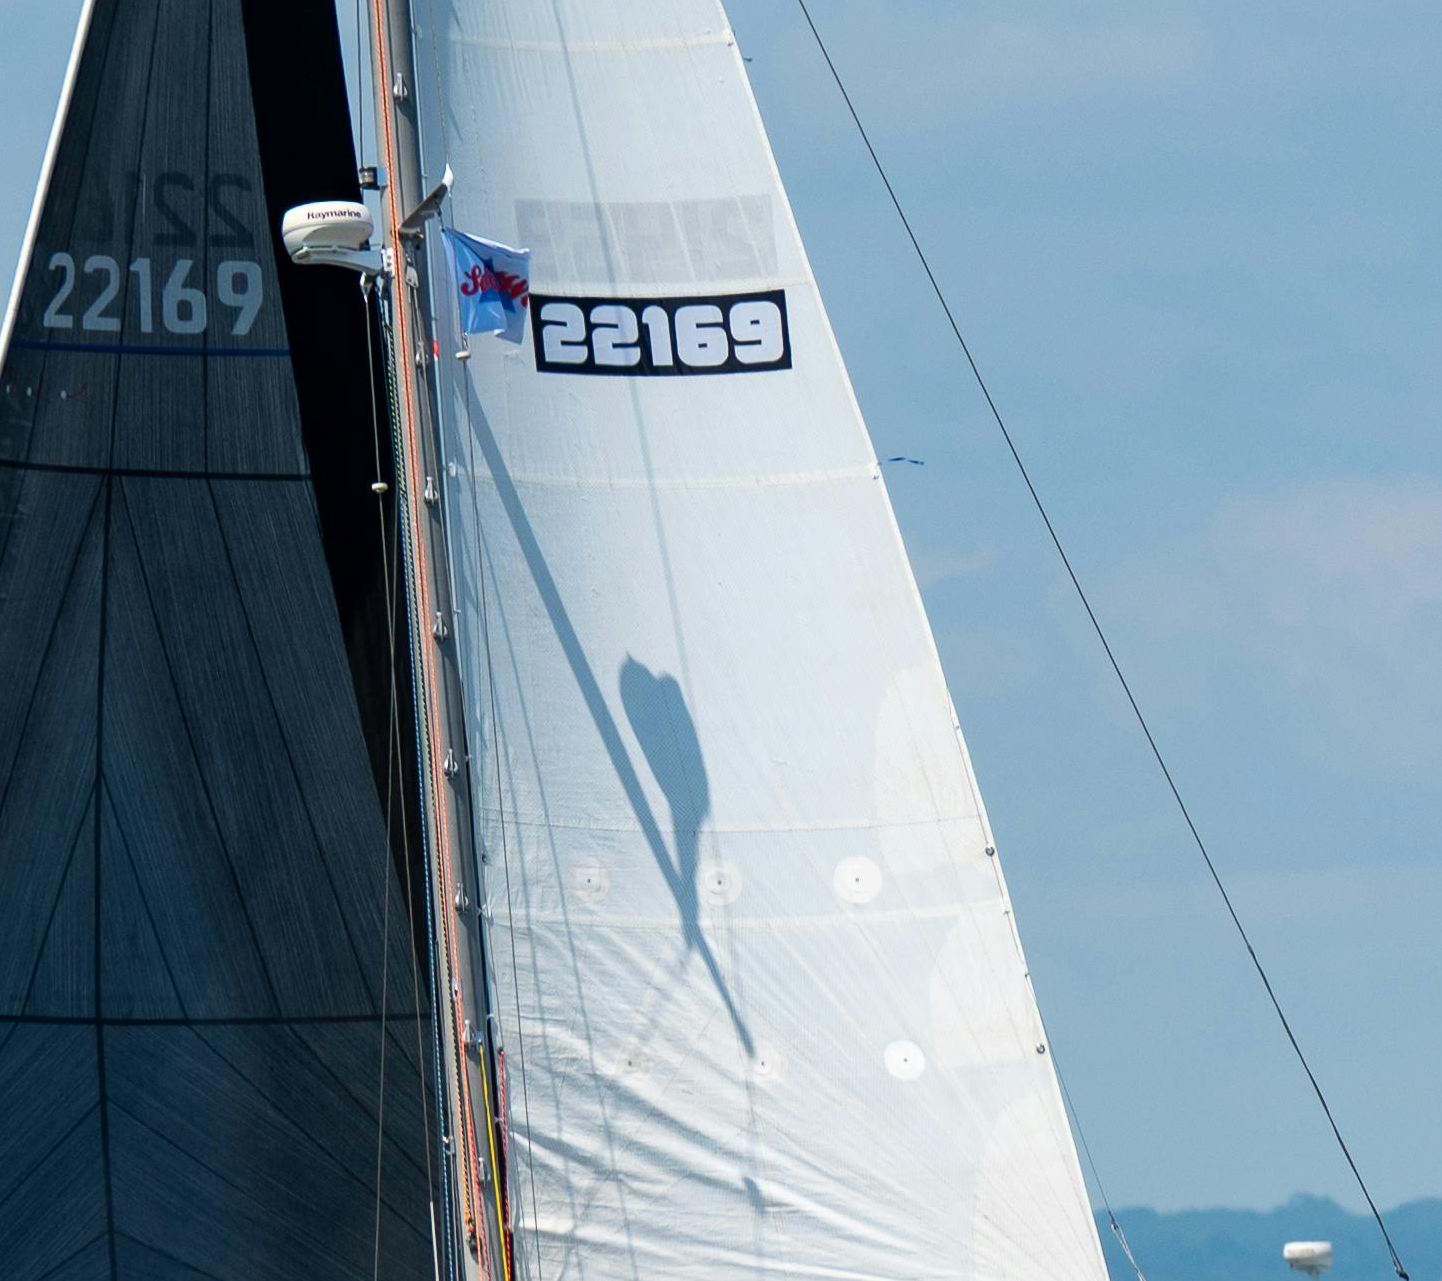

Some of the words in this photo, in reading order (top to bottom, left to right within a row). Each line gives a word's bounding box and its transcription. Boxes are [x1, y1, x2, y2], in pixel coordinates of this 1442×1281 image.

[307, 209, 362, 220] Raymarine
[43, 252, 264, 336] 22169
[539, 300, 785, 367] 22169
